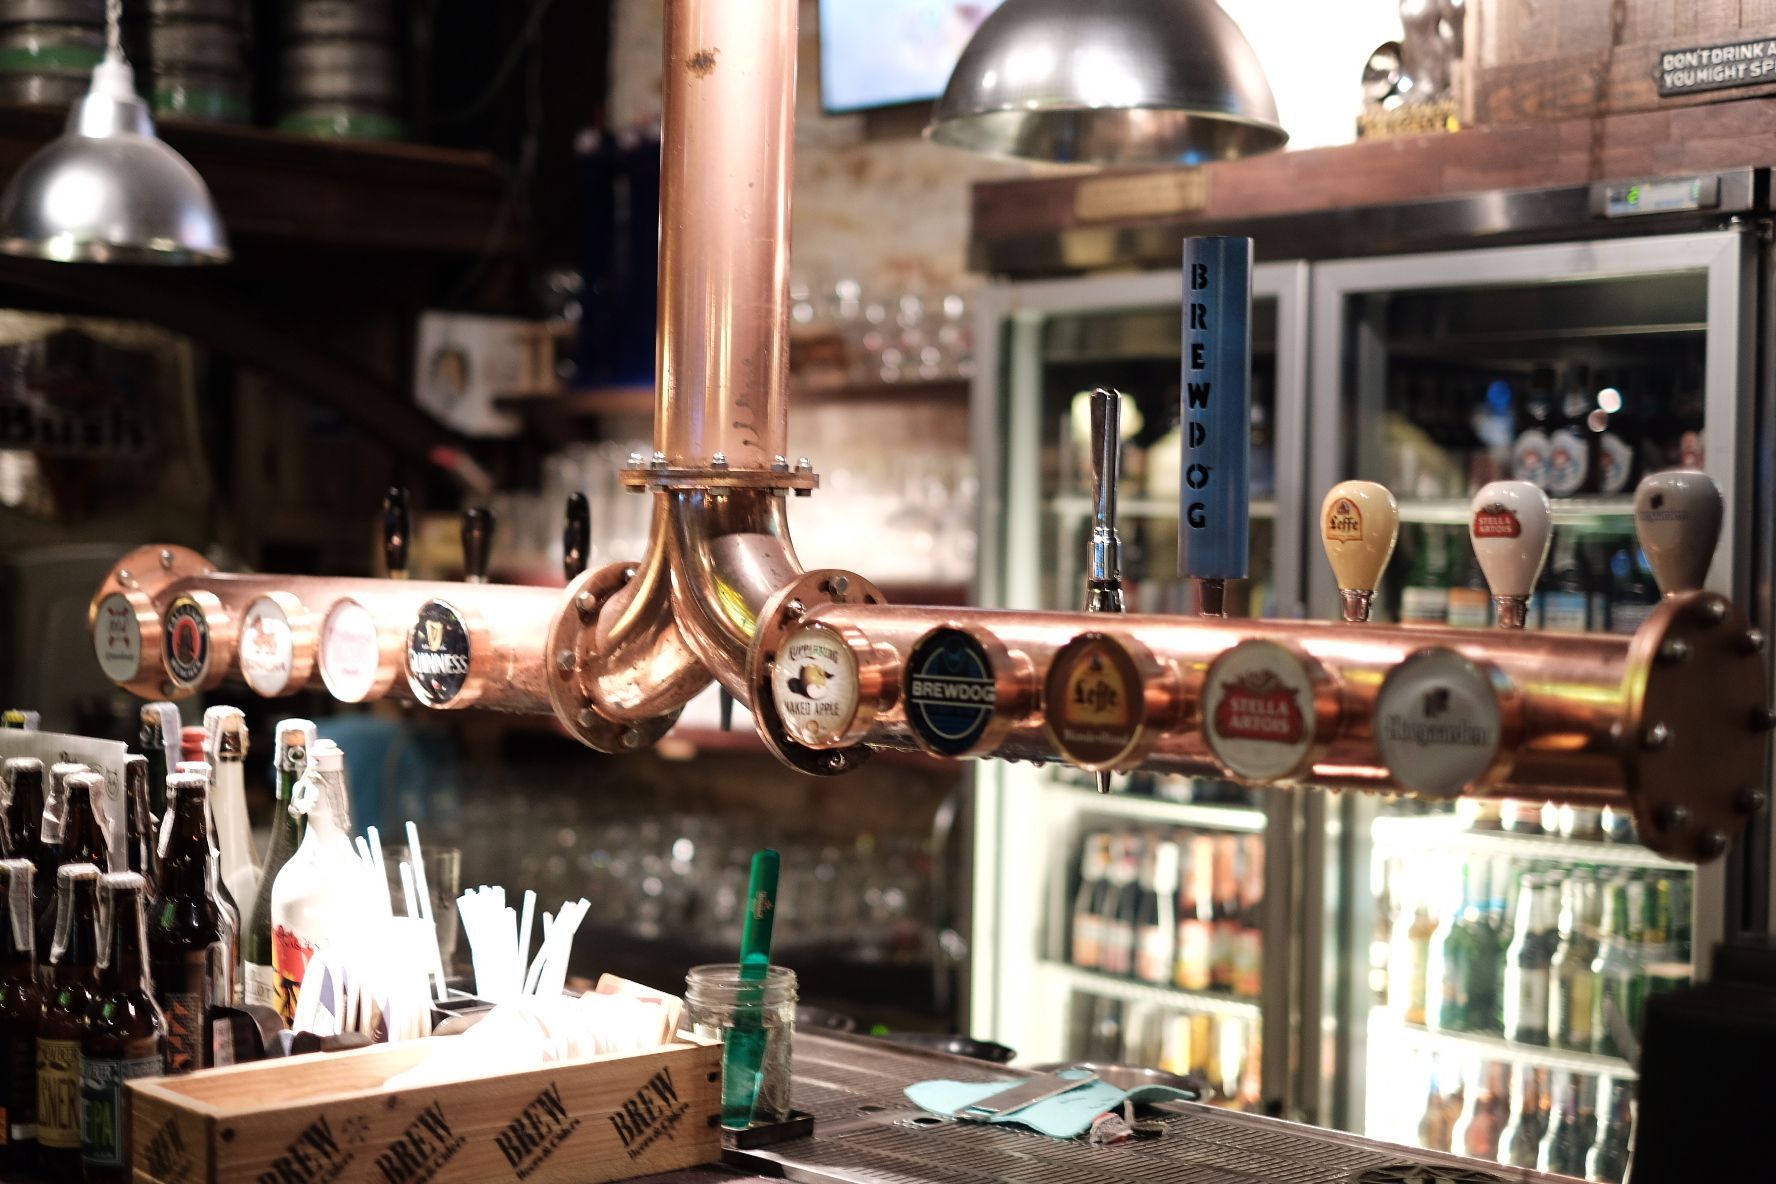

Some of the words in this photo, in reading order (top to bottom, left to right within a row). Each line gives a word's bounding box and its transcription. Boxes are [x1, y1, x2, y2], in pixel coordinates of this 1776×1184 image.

[1663, 48, 1711, 71] DON'T
[1711, 43, 1764, 64] DRINK
[1664, 69, 1696, 88] YOU
[1697, 62, 1747, 83] MIGHT
[1750, 58, 1776, 78] SP
[1186, 263, 1211, 529] BREWDOG
[1478, 516, 1512, 525] STELLA
[1479, 525, 1513, 533] ARTOIS
[911, 680, 997, 702] BREWDOG
[784, 700, 811, 716] NAKED
[815, 702, 839, 717] APPLE
[1229, 697, 1291, 717] STELLA
[1229, 714, 1291, 735] ARTOIS
[608, 1064, 680, 1147] BREW
[493, 1081, 568, 1169] BREW
[374, 1099, 452, 1184] BREW
